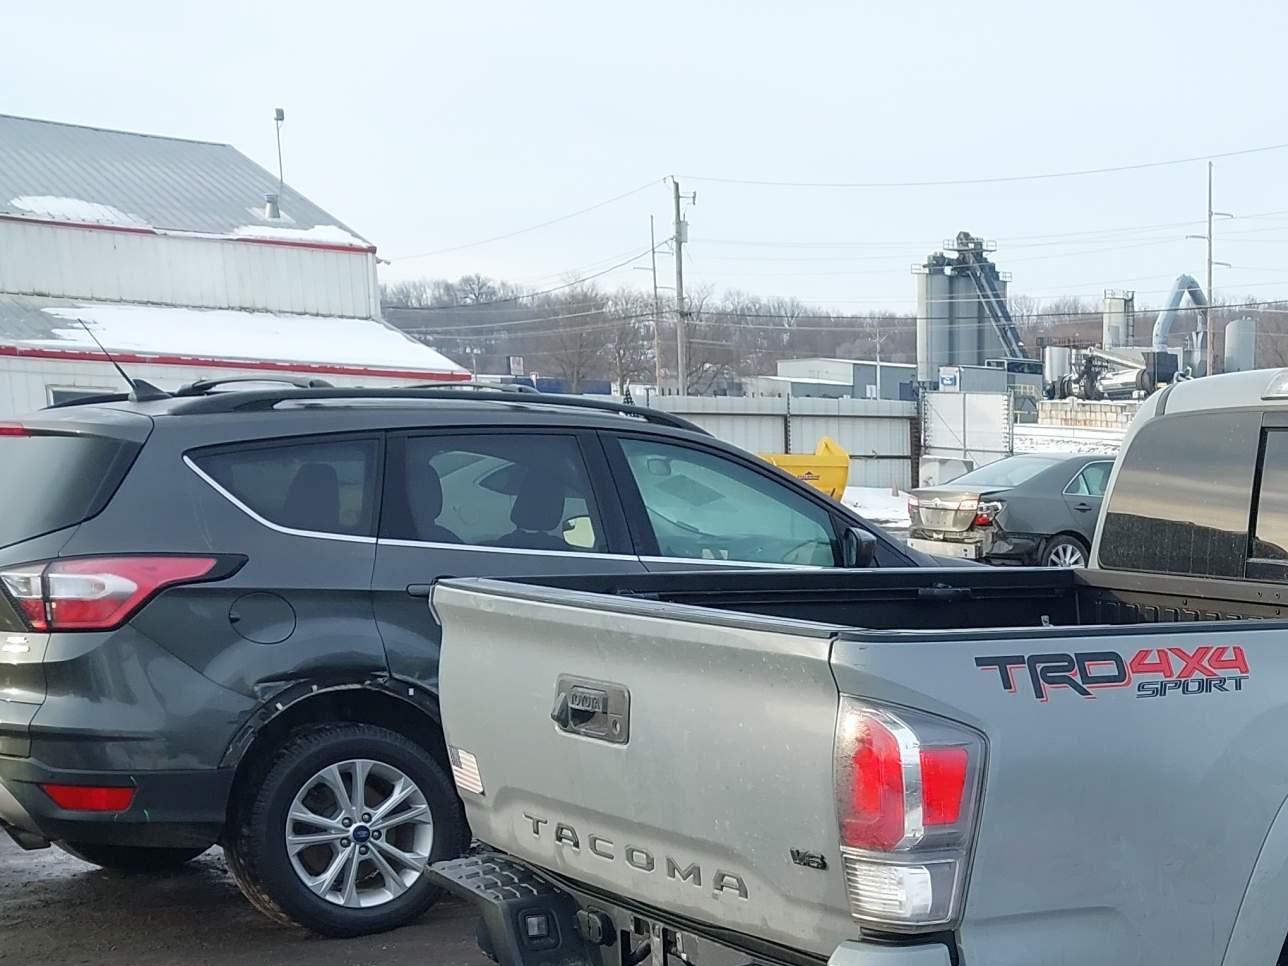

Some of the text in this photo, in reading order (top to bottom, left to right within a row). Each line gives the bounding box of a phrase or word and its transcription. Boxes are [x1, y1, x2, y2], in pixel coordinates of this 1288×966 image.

[974, 651, 1131, 701] TRD
[1135, 675, 1249, 698] SPORT
[524, 812, 749, 899] TACOMA
[790, 848, 828, 870] V6
